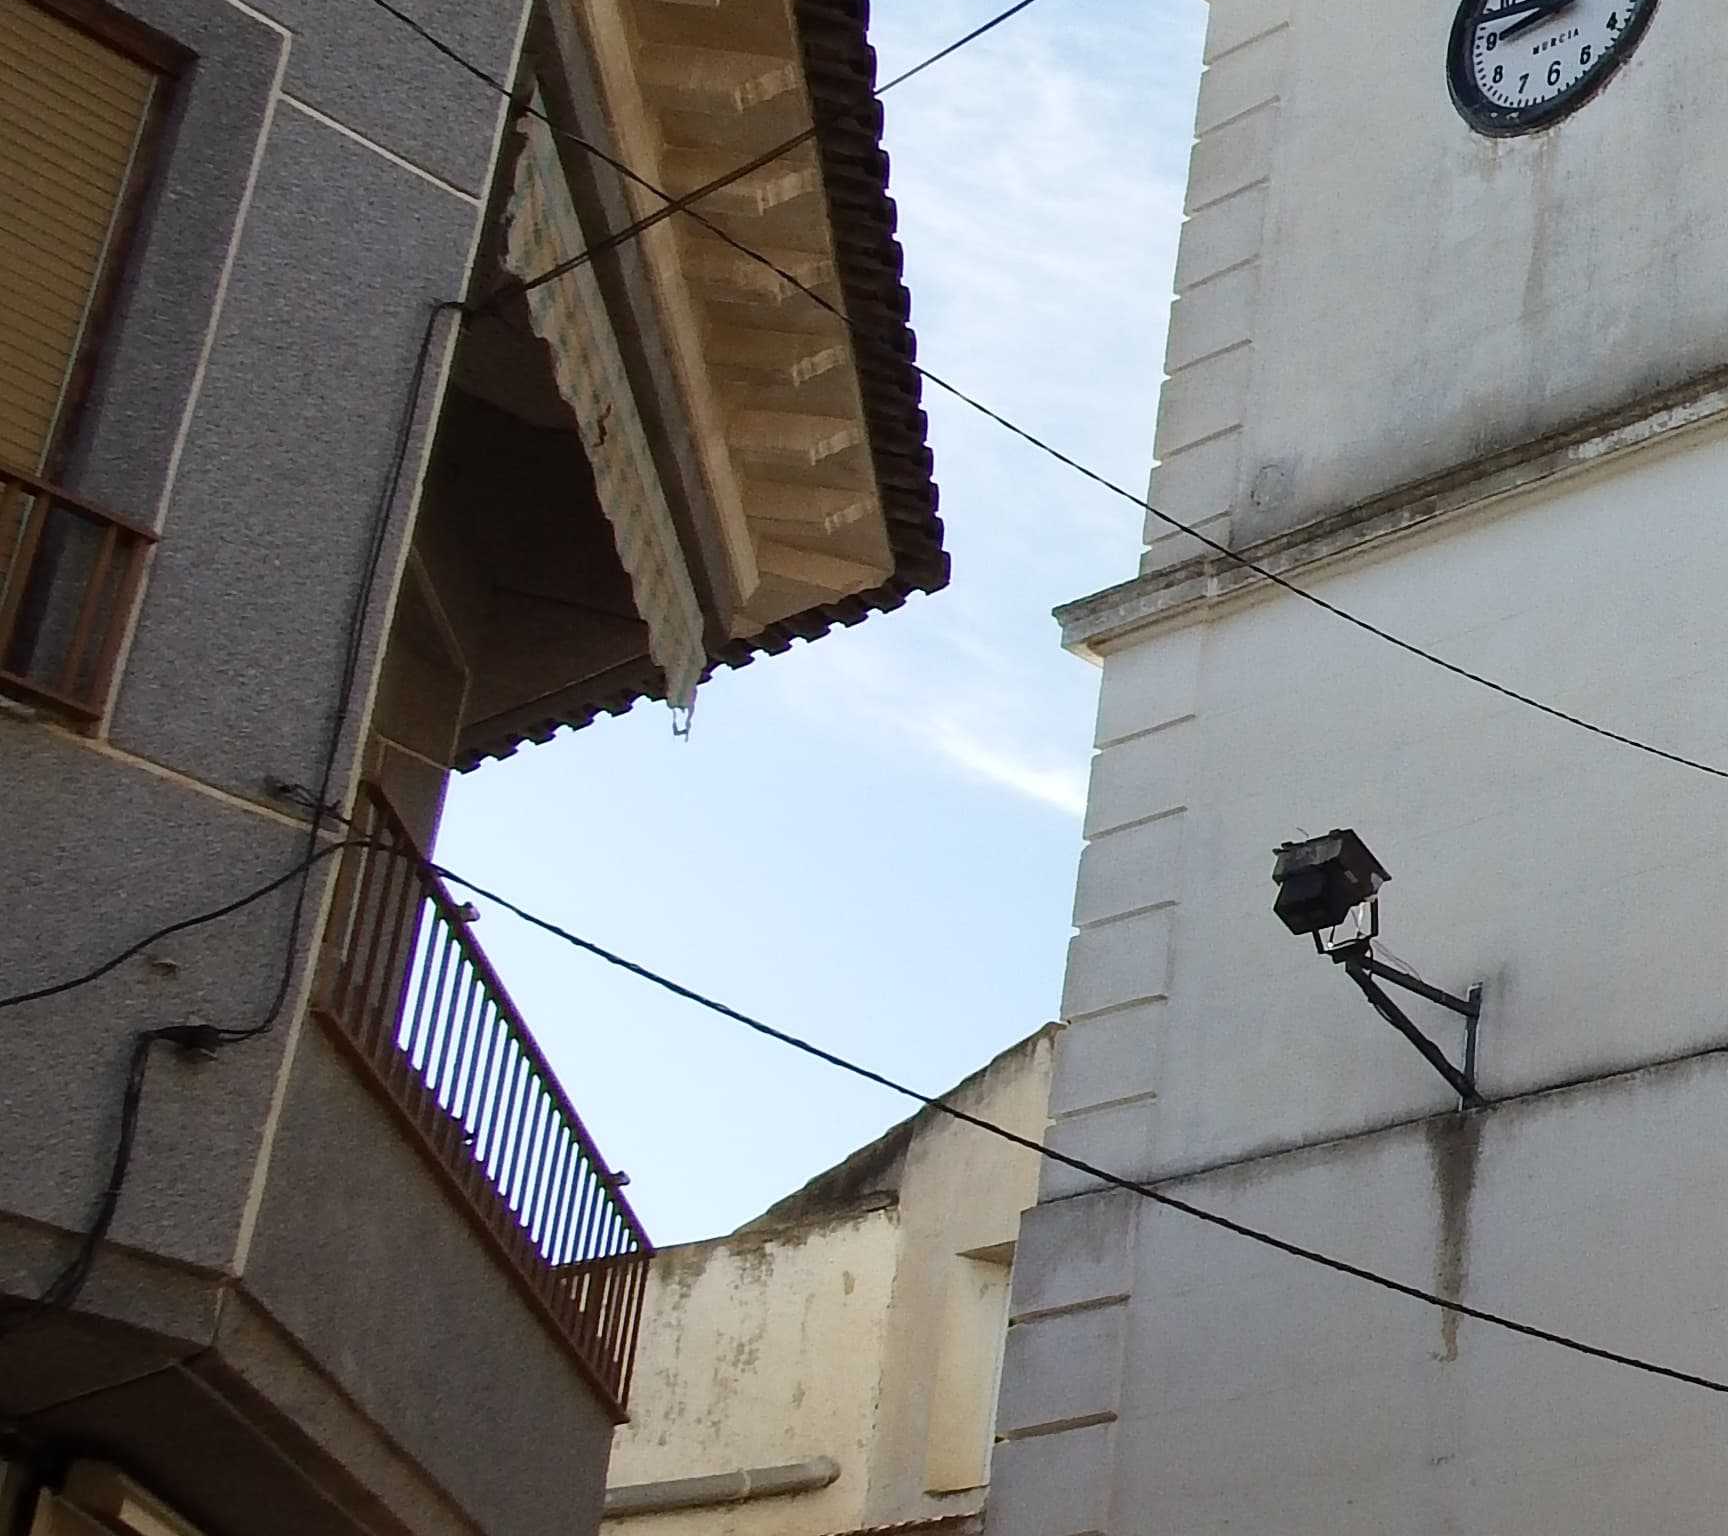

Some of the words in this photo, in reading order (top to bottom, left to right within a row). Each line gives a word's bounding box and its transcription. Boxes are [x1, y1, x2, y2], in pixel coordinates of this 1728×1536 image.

[1606, 12, 1618, 30] 4
[1486, 32, 1498, 51] 9
[1532, 28, 1579, 55] MURCIA
[1580, 45, 1592, 64] 5
[1493, 65, 1503, 83] 8
[1547, 61, 1561, 86] 6
[1519, 73, 1529, 94] 7
